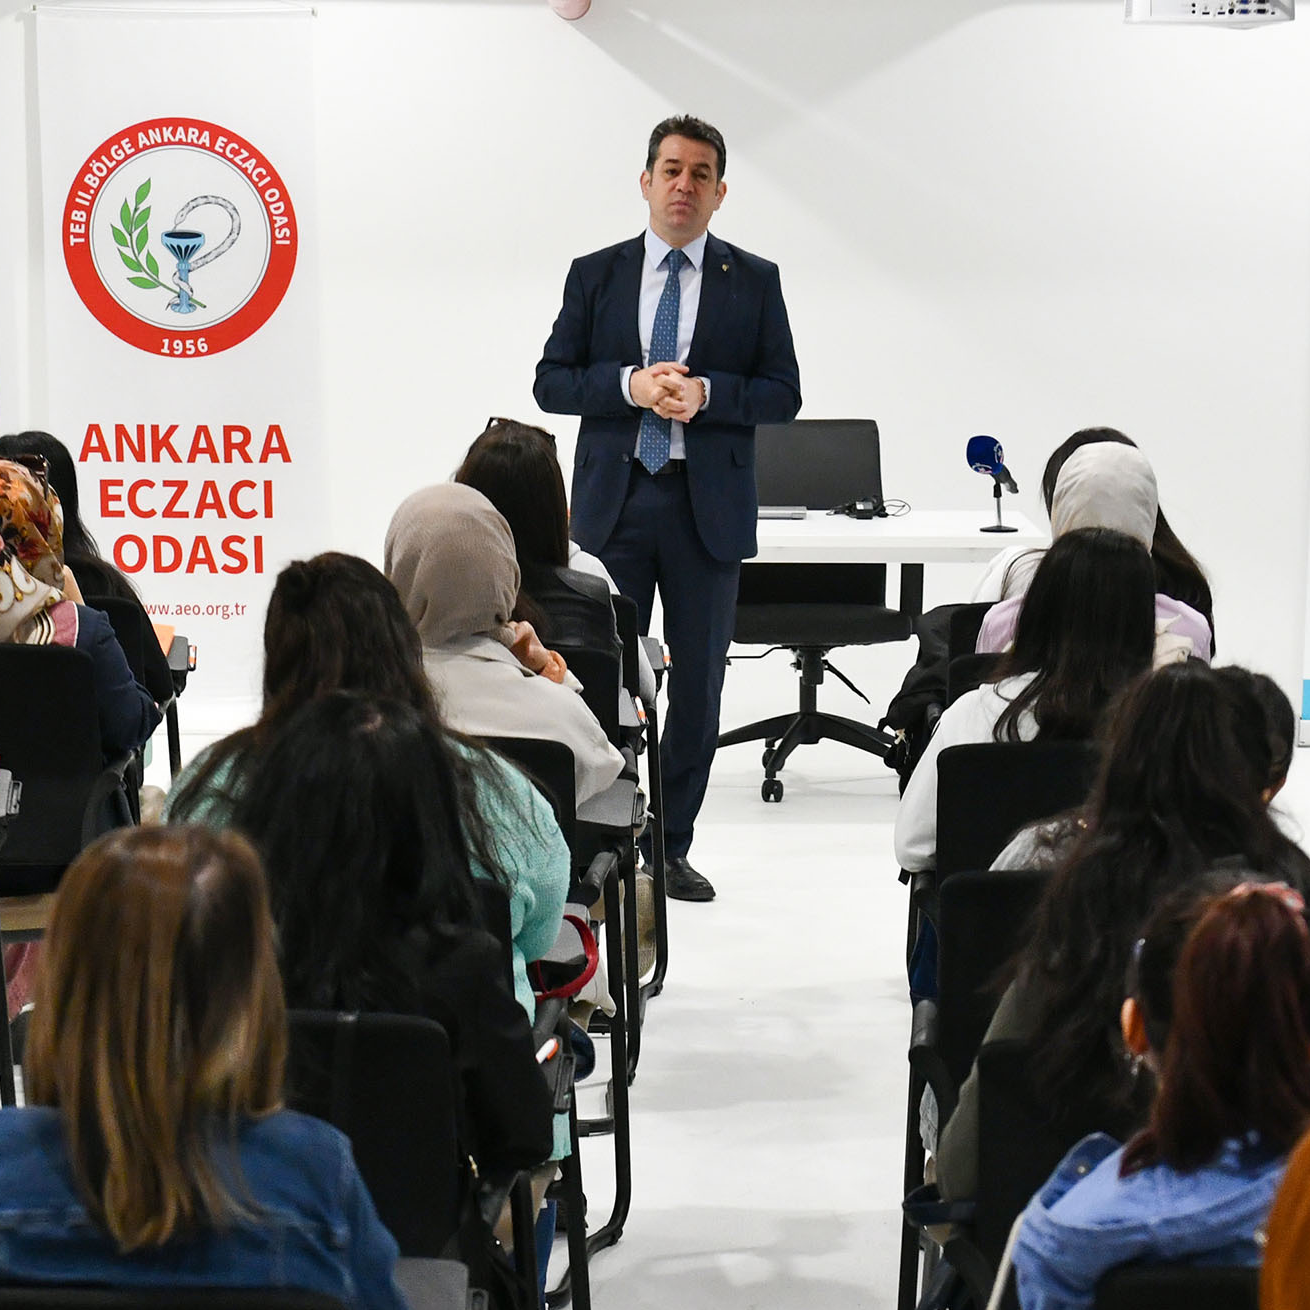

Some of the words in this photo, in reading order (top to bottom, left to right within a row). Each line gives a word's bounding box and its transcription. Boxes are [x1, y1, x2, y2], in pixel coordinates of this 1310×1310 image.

[69, 211, 87, 246] TEB
[138, 126, 211, 149] ANKARA
[214, 136, 271, 187] ECZACI
[264, 188, 290, 245] ODASI
[160, 338, 208, 355] 1956
[78, 423, 292, 464] ANKARA
[99, 478, 273, 519] ECZACI
[112, 534, 264, 574] ODASI
[145, 602, 247, 620] ww.aeo.org.tr
